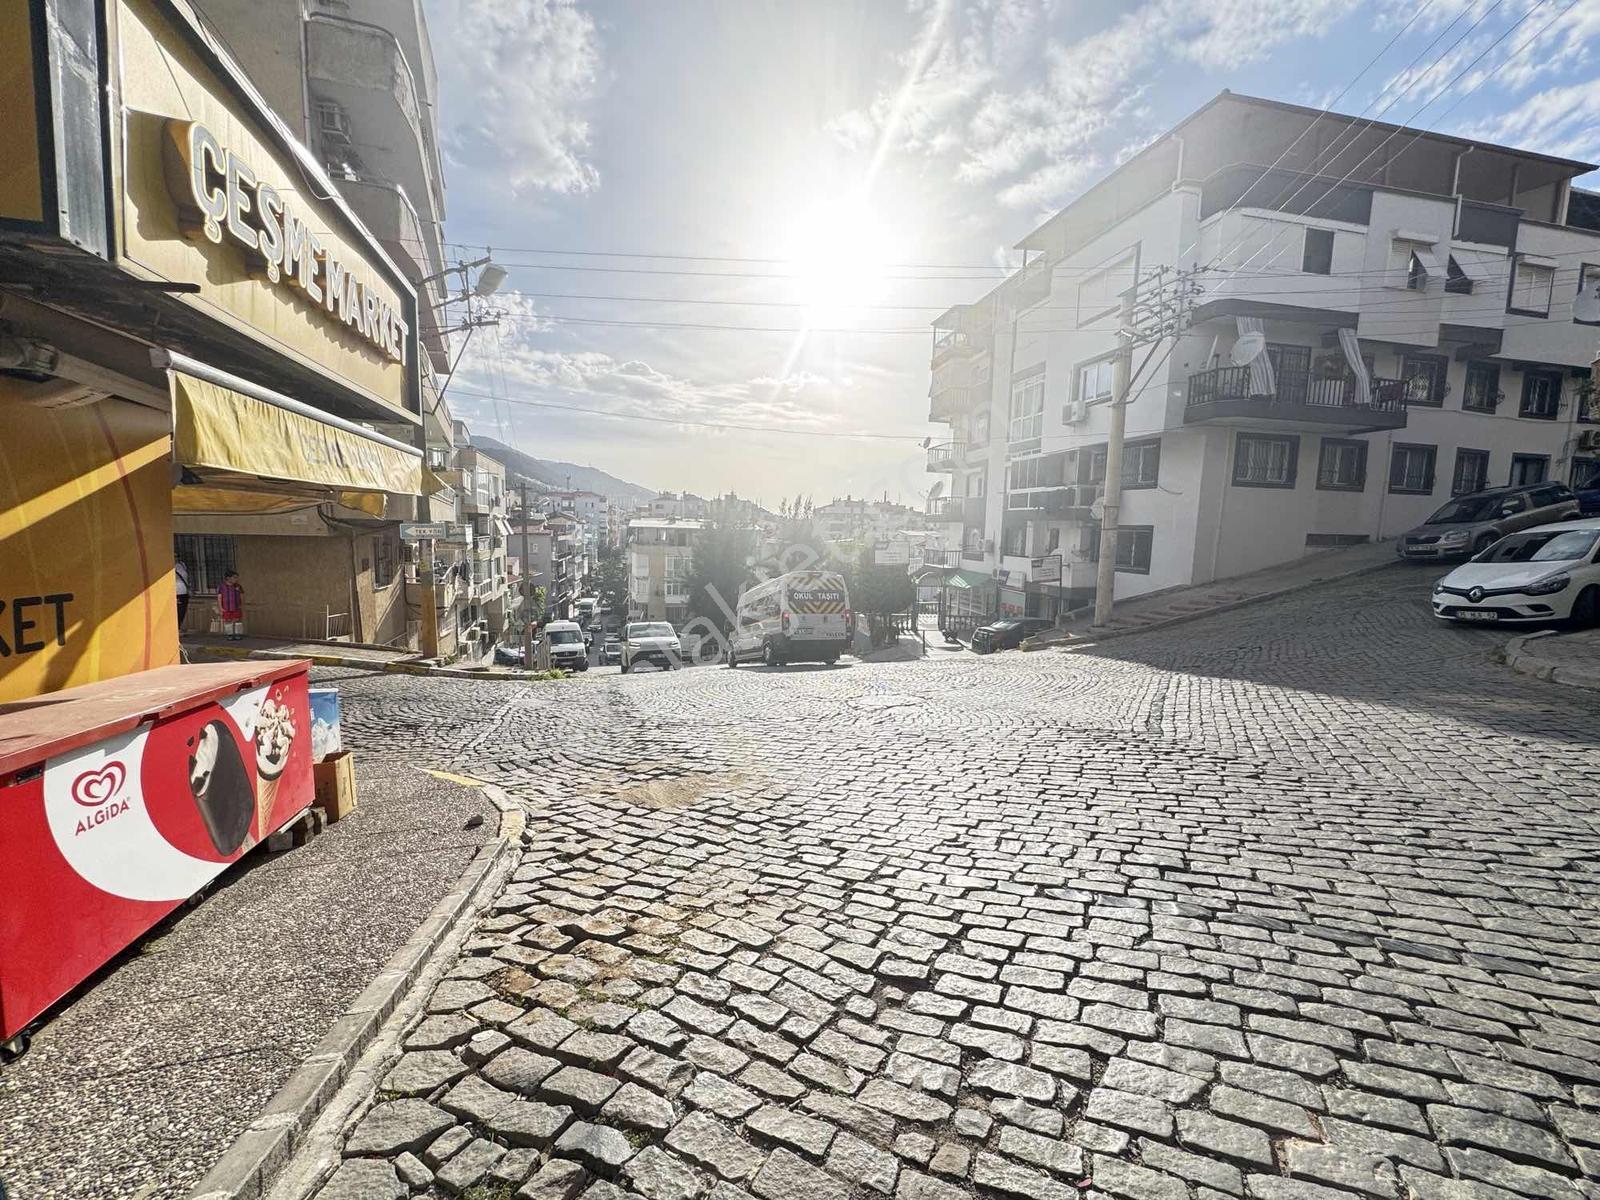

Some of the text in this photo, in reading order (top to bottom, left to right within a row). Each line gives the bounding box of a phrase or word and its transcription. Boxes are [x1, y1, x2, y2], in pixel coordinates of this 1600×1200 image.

[188, 120, 409, 366] ÇEŞME MARKET
[793, 592, 814, 600] OKUL
